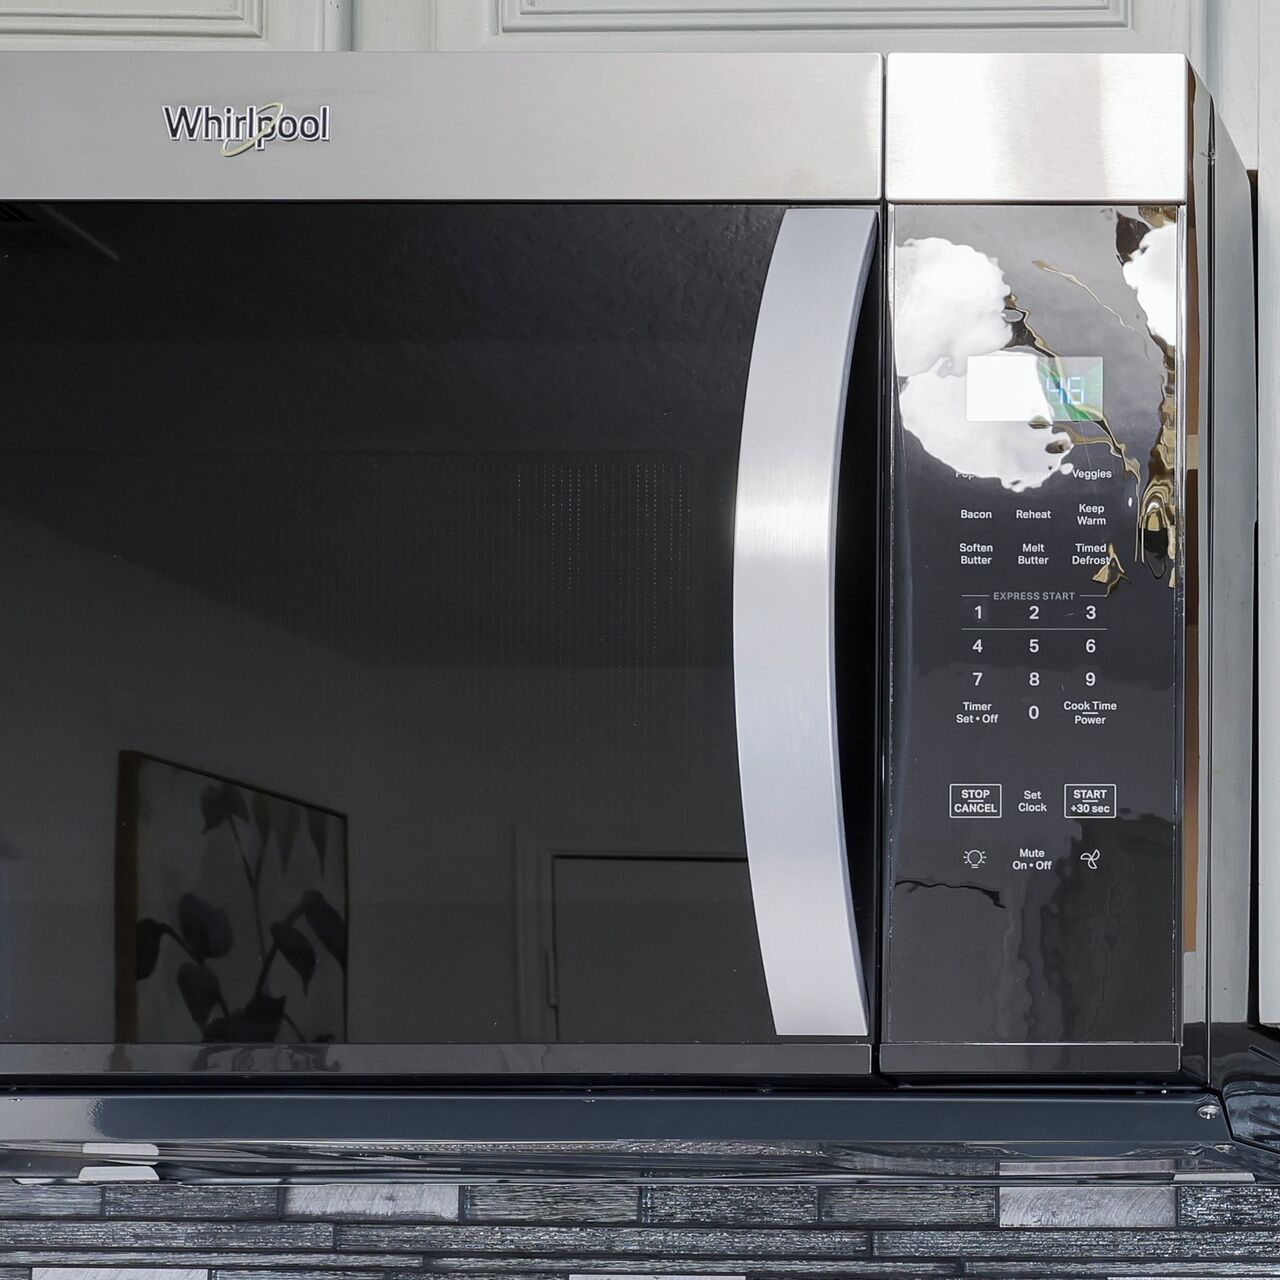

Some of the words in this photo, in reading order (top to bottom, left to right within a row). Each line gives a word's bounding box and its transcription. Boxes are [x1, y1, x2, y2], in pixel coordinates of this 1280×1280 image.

[162, 105, 330, 150] Whirlpool
[1072, 469, 1112, 480] Veggies
[960, 509, 992, 519] Bacon
[1016, 509, 1051, 519] Reheat
[1079, 504, 1104, 515] Keep
[1077, 516, 1106, 525] Warm
[959, 543, 993, 553] Soften
[1022, 543, 1044, 553] Melt
[1075, 543, 1107, 553] Timed
[960, 555, 992, 565] Butter
[1018, 555, 1049, 565] Butter
[1072, 555, 1110, 565] Defrost
[993, 592, 1040, 600] EXPRESS
[1043, 592, 1075, 600] START
[973, 606, 983, 620] 1
[1029, 606, 1040, 620] 2
[1085, 606, 1096, 620] 3
[972, 639, 983, 653] 4
[1029, 639, 1040, 653] 5
[1085, 639, 1096, 653] 6
[972, 672, 983, 686] 7
[1029, 672, 1040, 686] 8
[1085, 672, 1096, 686] 9
[962, 702, 992, 711] Timer
[1063, 701, 1090, 710] Cook
[1092, 701, 1117, 710] Time
[1028, 706, 1039, 719] 0
[956, 714, 975, 723] Set
[982, 714, 998, 723] Off
[1074, 715, 1106, 725] Power
[961, 790, 990, 799] STOP
[1023, 791, 1041, 799] Set
[1073, 790, 1107, 799] START
[954, 804, 997, 813] CANCEL
[1018, 803, 1047, 812] Clock
[1070, 804, 1090, 813] +30
[1019, 849, 1045, 858] Mute
[1012, 861, 1027, 870] On
[1035, 861, 1052, 870] Off
